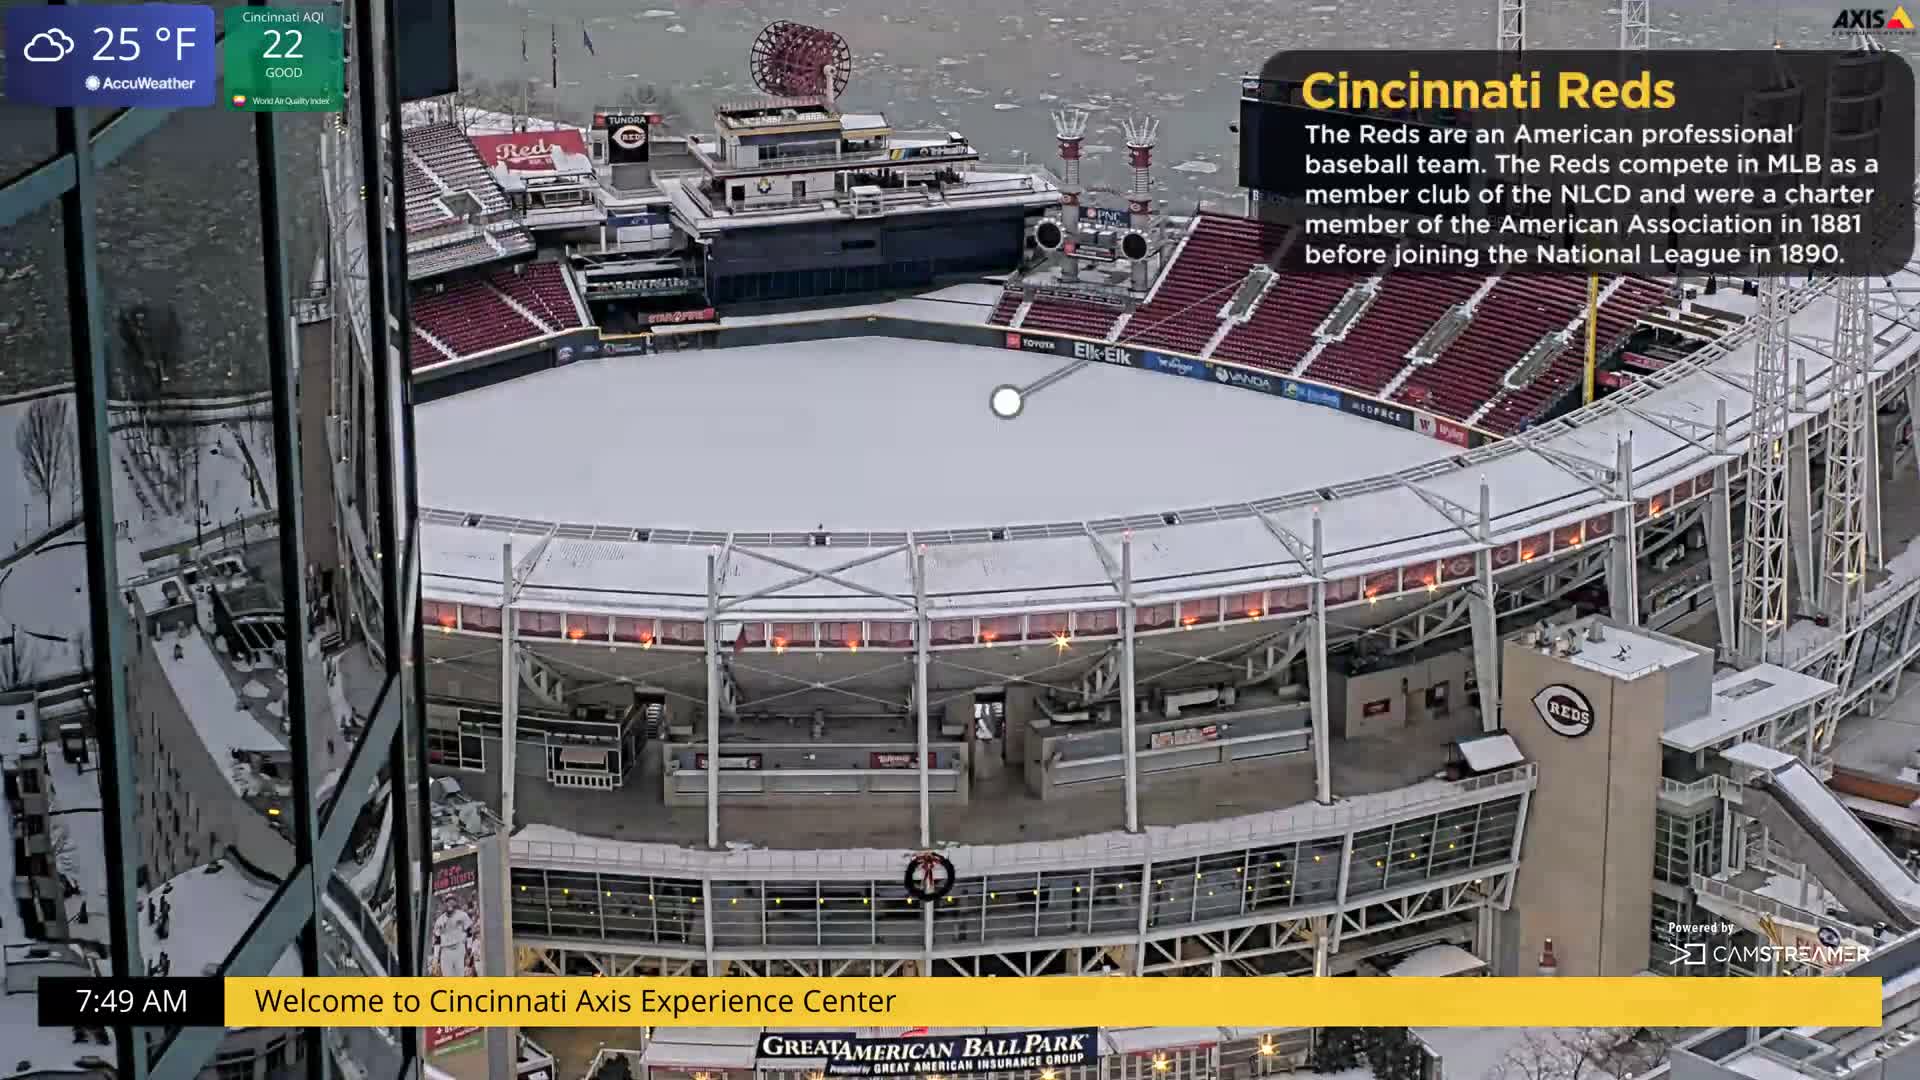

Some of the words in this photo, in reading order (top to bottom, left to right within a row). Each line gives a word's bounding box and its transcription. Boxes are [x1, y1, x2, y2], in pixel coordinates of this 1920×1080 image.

[608, 116, 646, 124] TUNDRA
[1022, 339, 1056, 349] TOYOTA
[1230, 370, 1271, 390] VANDA
[1550, 701, 1590, 725] REDS
[873, 1062, 909, 1074] GREAT
[914, 1060, 973, 1073] AMERICAN
[978, 1055, 1042, 1070] INSURANCE
[1046, 1052, 1085, 1065] GROUP
